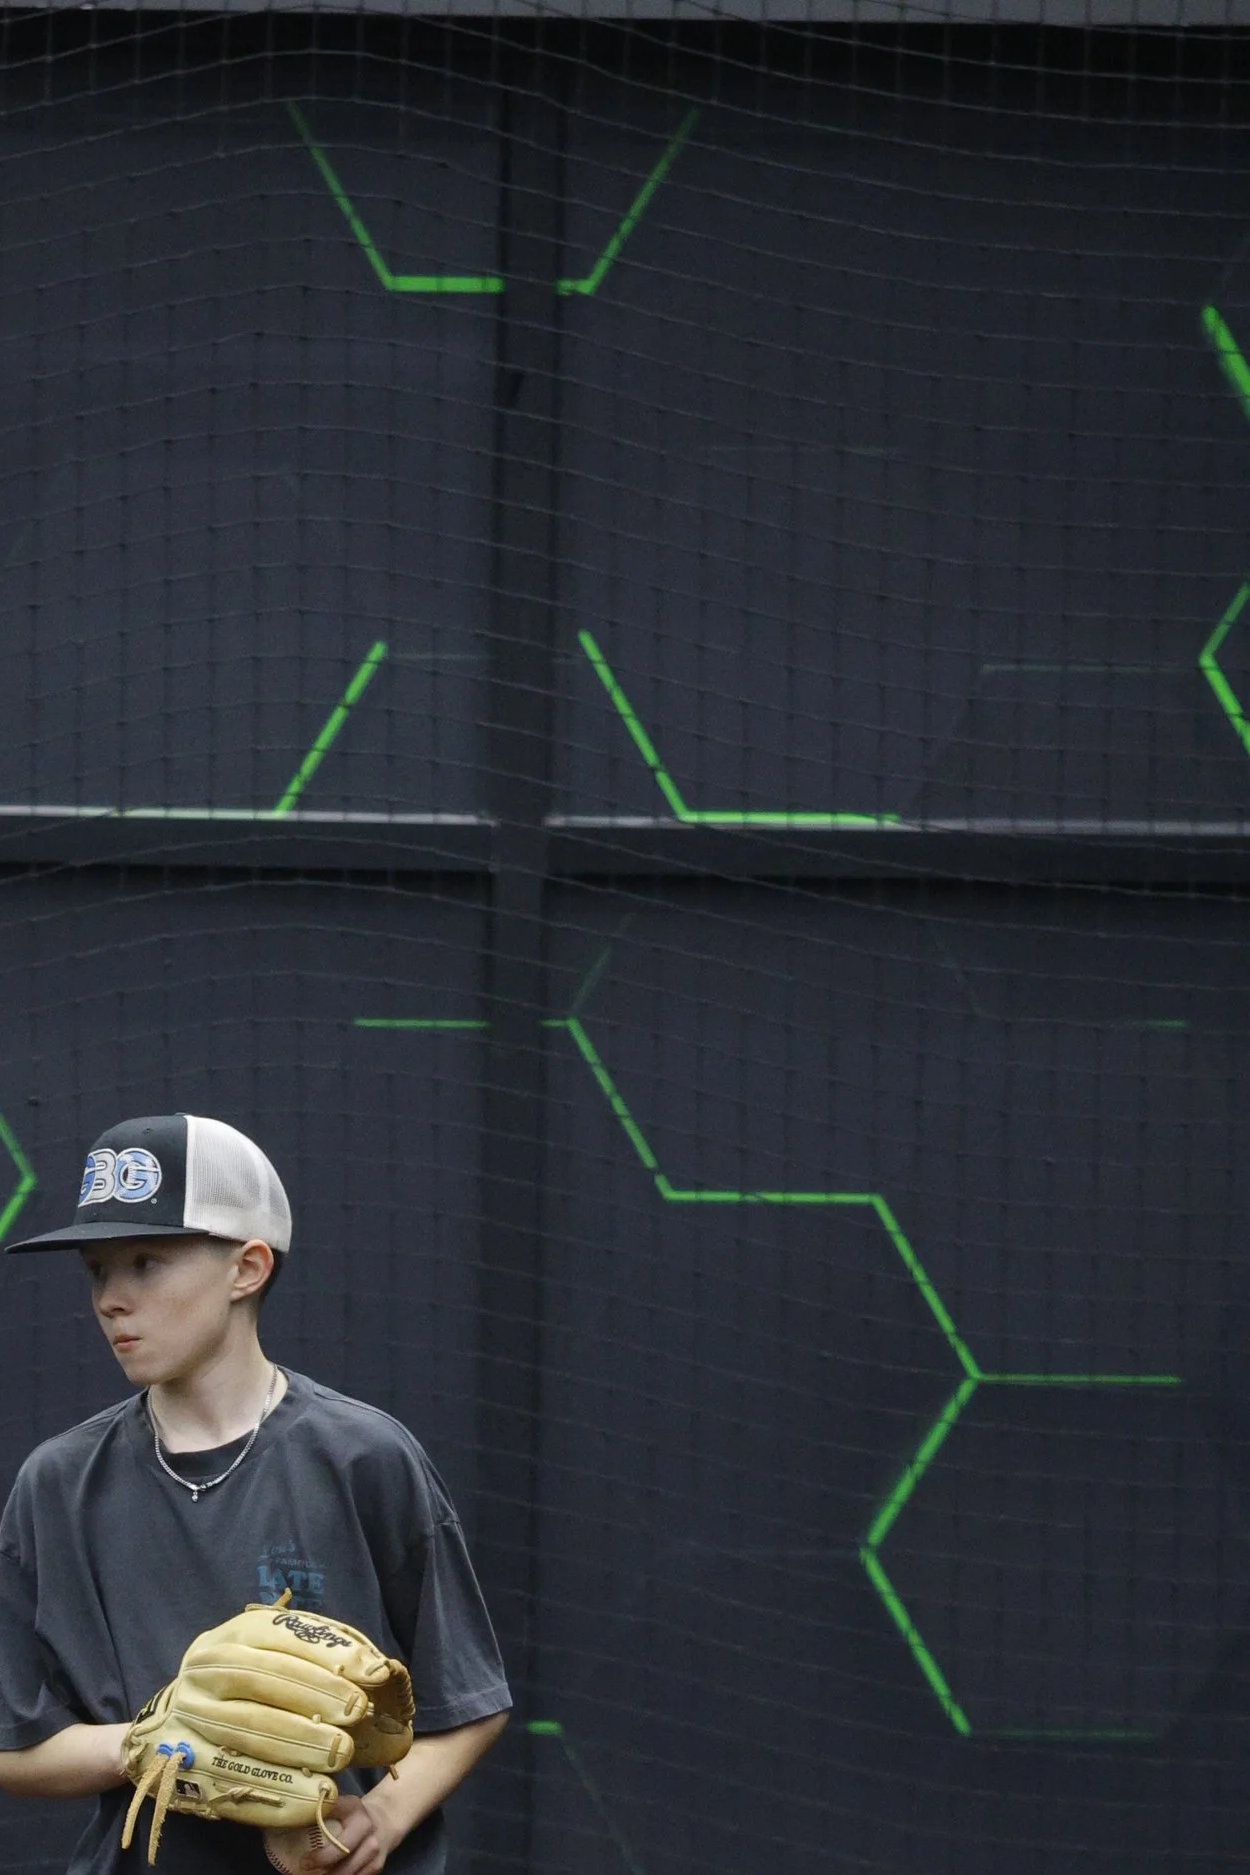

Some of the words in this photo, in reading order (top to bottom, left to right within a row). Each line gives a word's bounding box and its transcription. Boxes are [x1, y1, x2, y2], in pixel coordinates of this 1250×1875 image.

[273, 1614, 353, 1648] Rawlings
[211, 1757, 229, 1769] THE
[228, 1762, 251, 1775] GOLD
[251, 1768, 279, 1781] GLOVE
[279, 1774, 294, 1784] CO.
